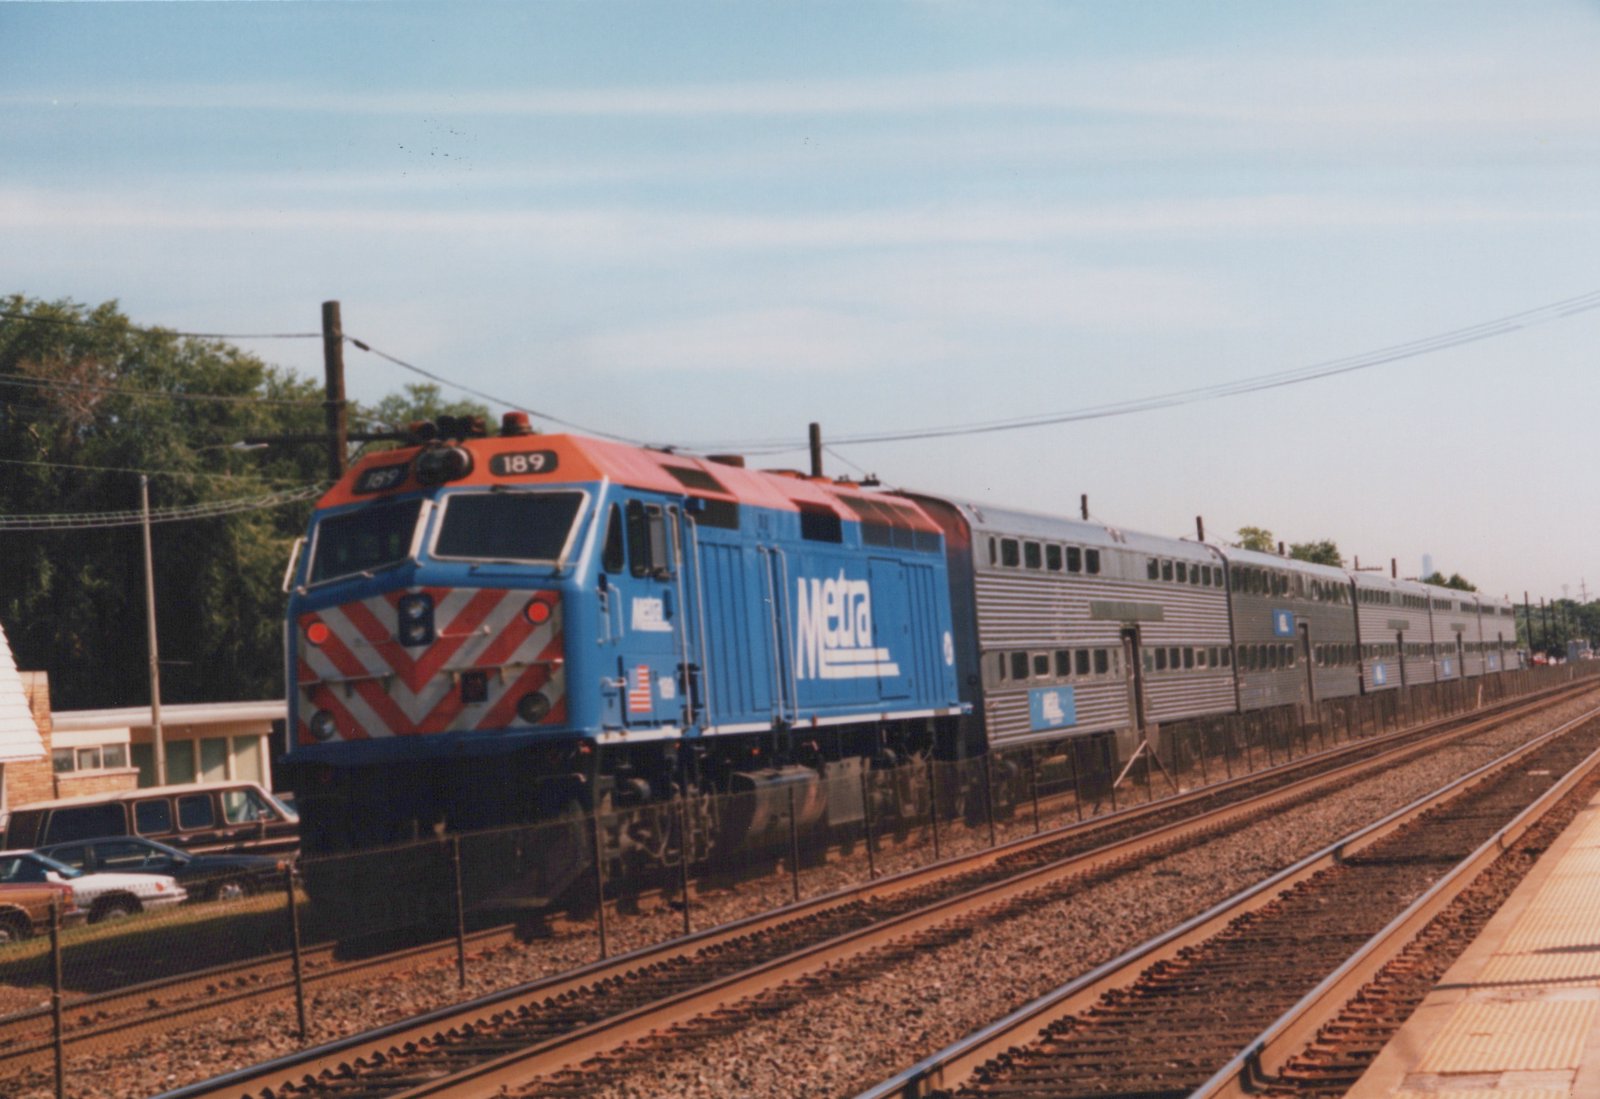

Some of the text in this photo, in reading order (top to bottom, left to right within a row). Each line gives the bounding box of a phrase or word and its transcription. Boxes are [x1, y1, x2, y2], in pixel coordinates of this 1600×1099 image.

[503, 453, 545, 473] 189
[365, 467, 400, 488] 189
[797, 568, 873, 680] Metra
